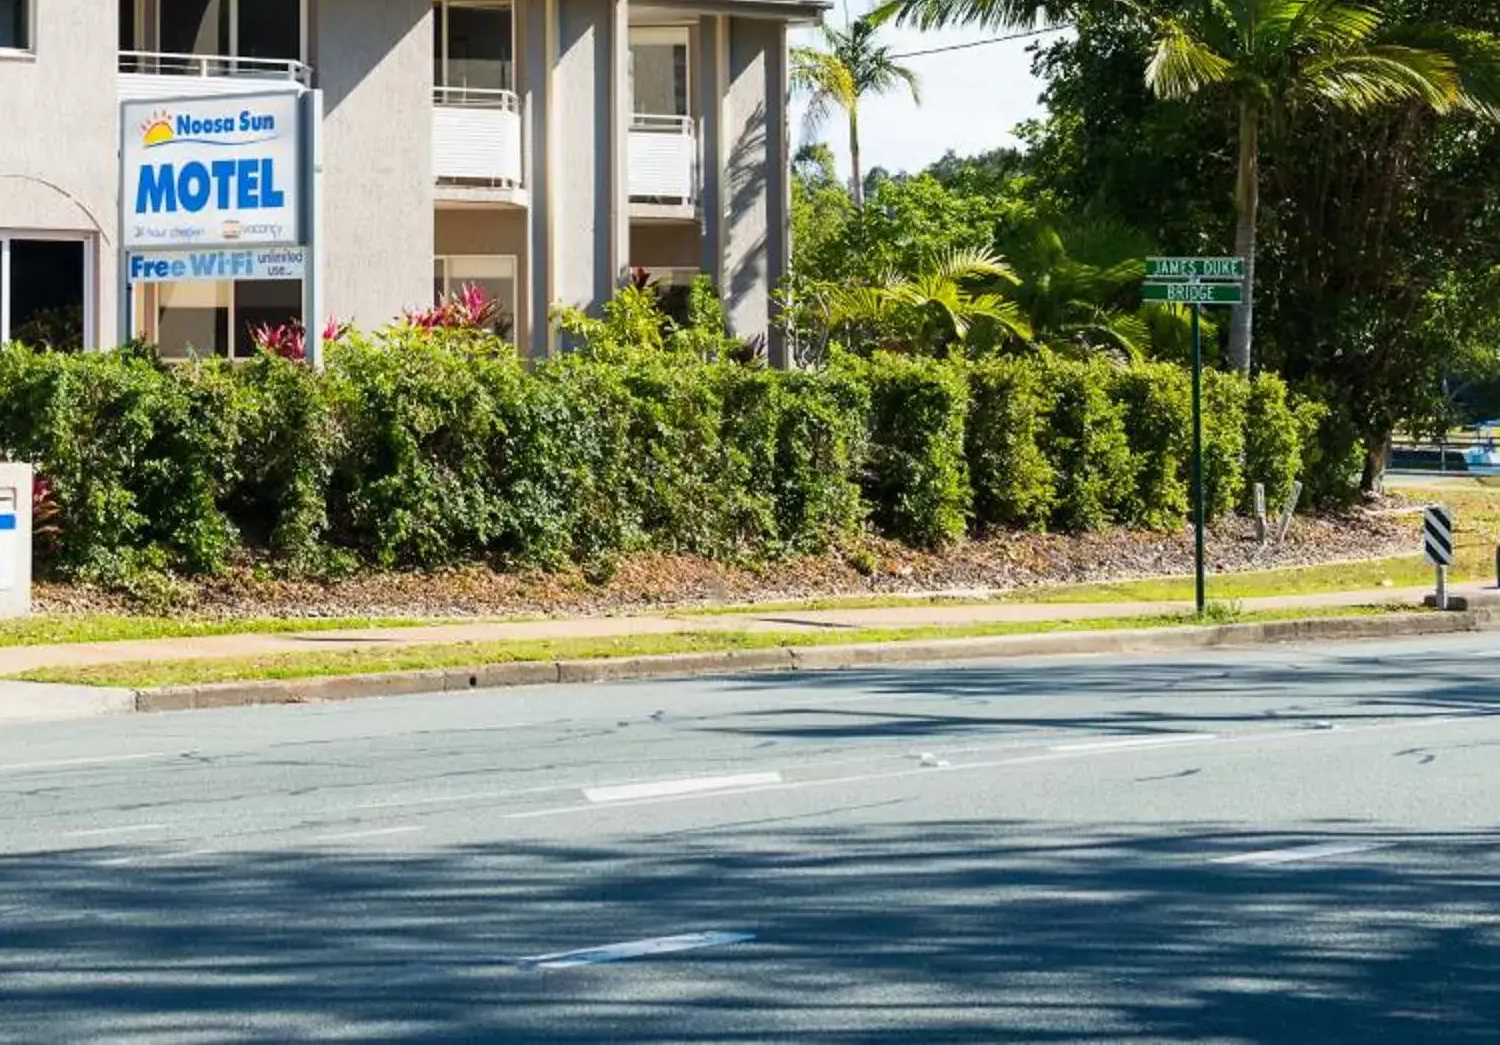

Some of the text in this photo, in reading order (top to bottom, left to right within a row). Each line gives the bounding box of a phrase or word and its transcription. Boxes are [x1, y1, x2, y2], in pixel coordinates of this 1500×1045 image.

[177, 110, 275, 136] Noosa Sun
[135, 158, 285, 215] MOTEL
[131, 255, 186, 278] Free
[1154, 260, 1238, 275] JAMES DUKE
[1167, 284, 1215, 300] BRIDGE
